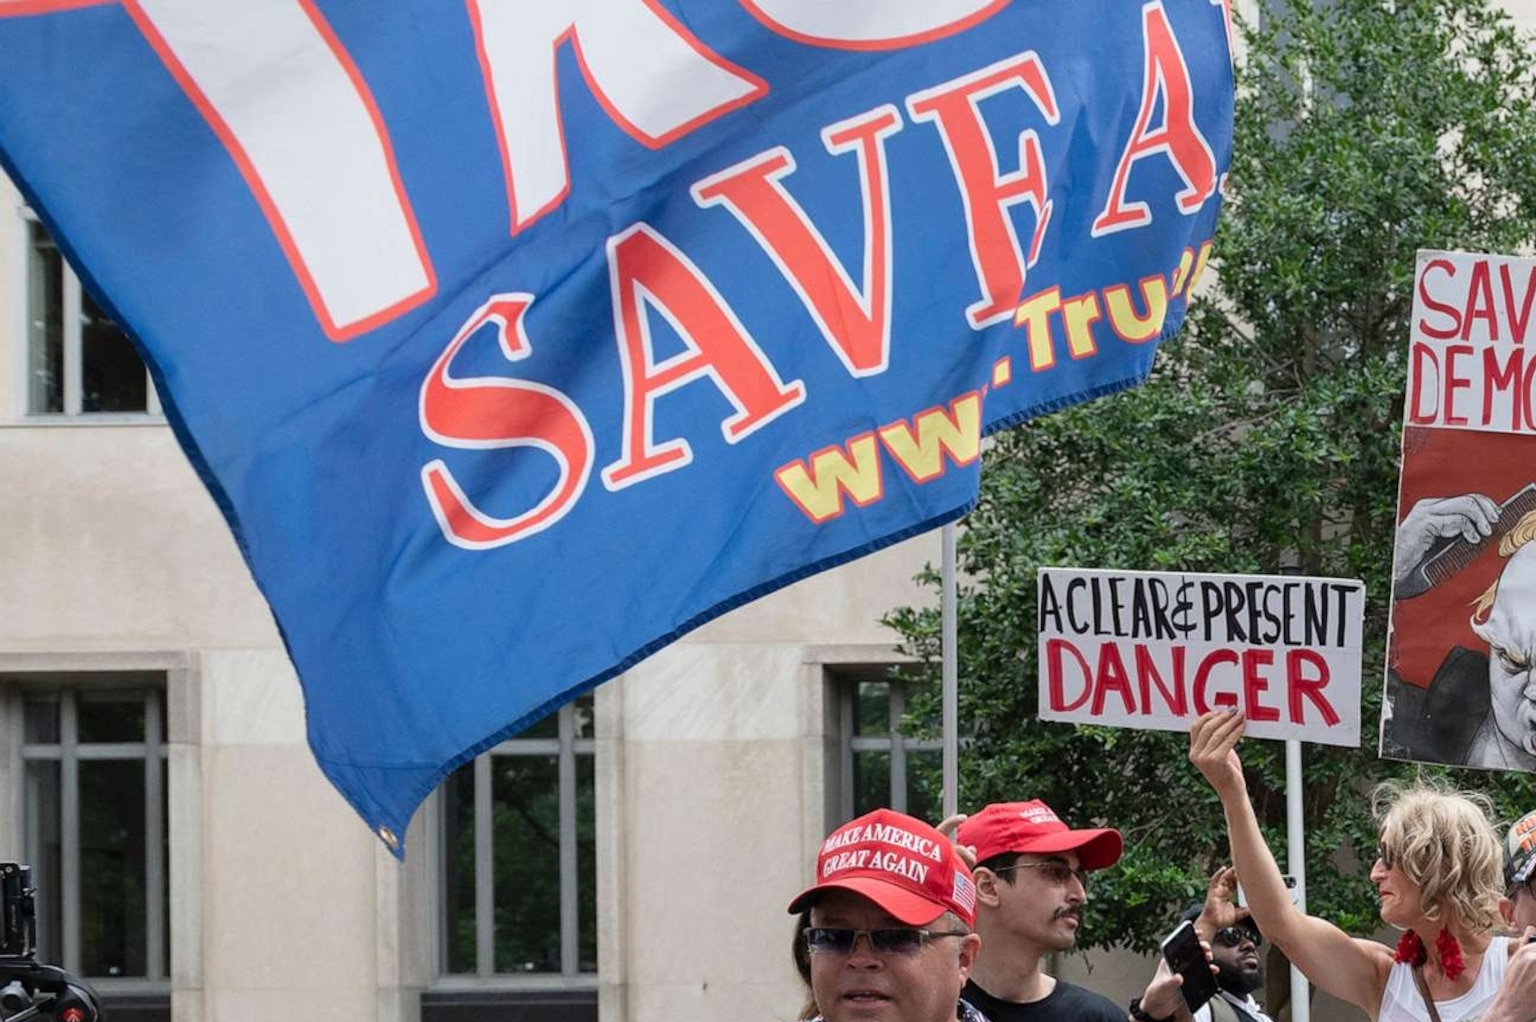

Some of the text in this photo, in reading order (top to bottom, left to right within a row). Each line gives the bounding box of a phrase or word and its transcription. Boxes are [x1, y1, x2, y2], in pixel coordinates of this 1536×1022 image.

[418, 50, 1061, 551] SAVE
[1040, 573, 1064, 634] A
[1066, 577, 1177, 641] CLEAR
[1203, 581, 1361, 648] PRESENT
[1046, 638, 1342, 728] DANGER
[821, 823, 943, 862] MAKE AMERICA
[823, 849, 929, 884] GREAT AGAIN
